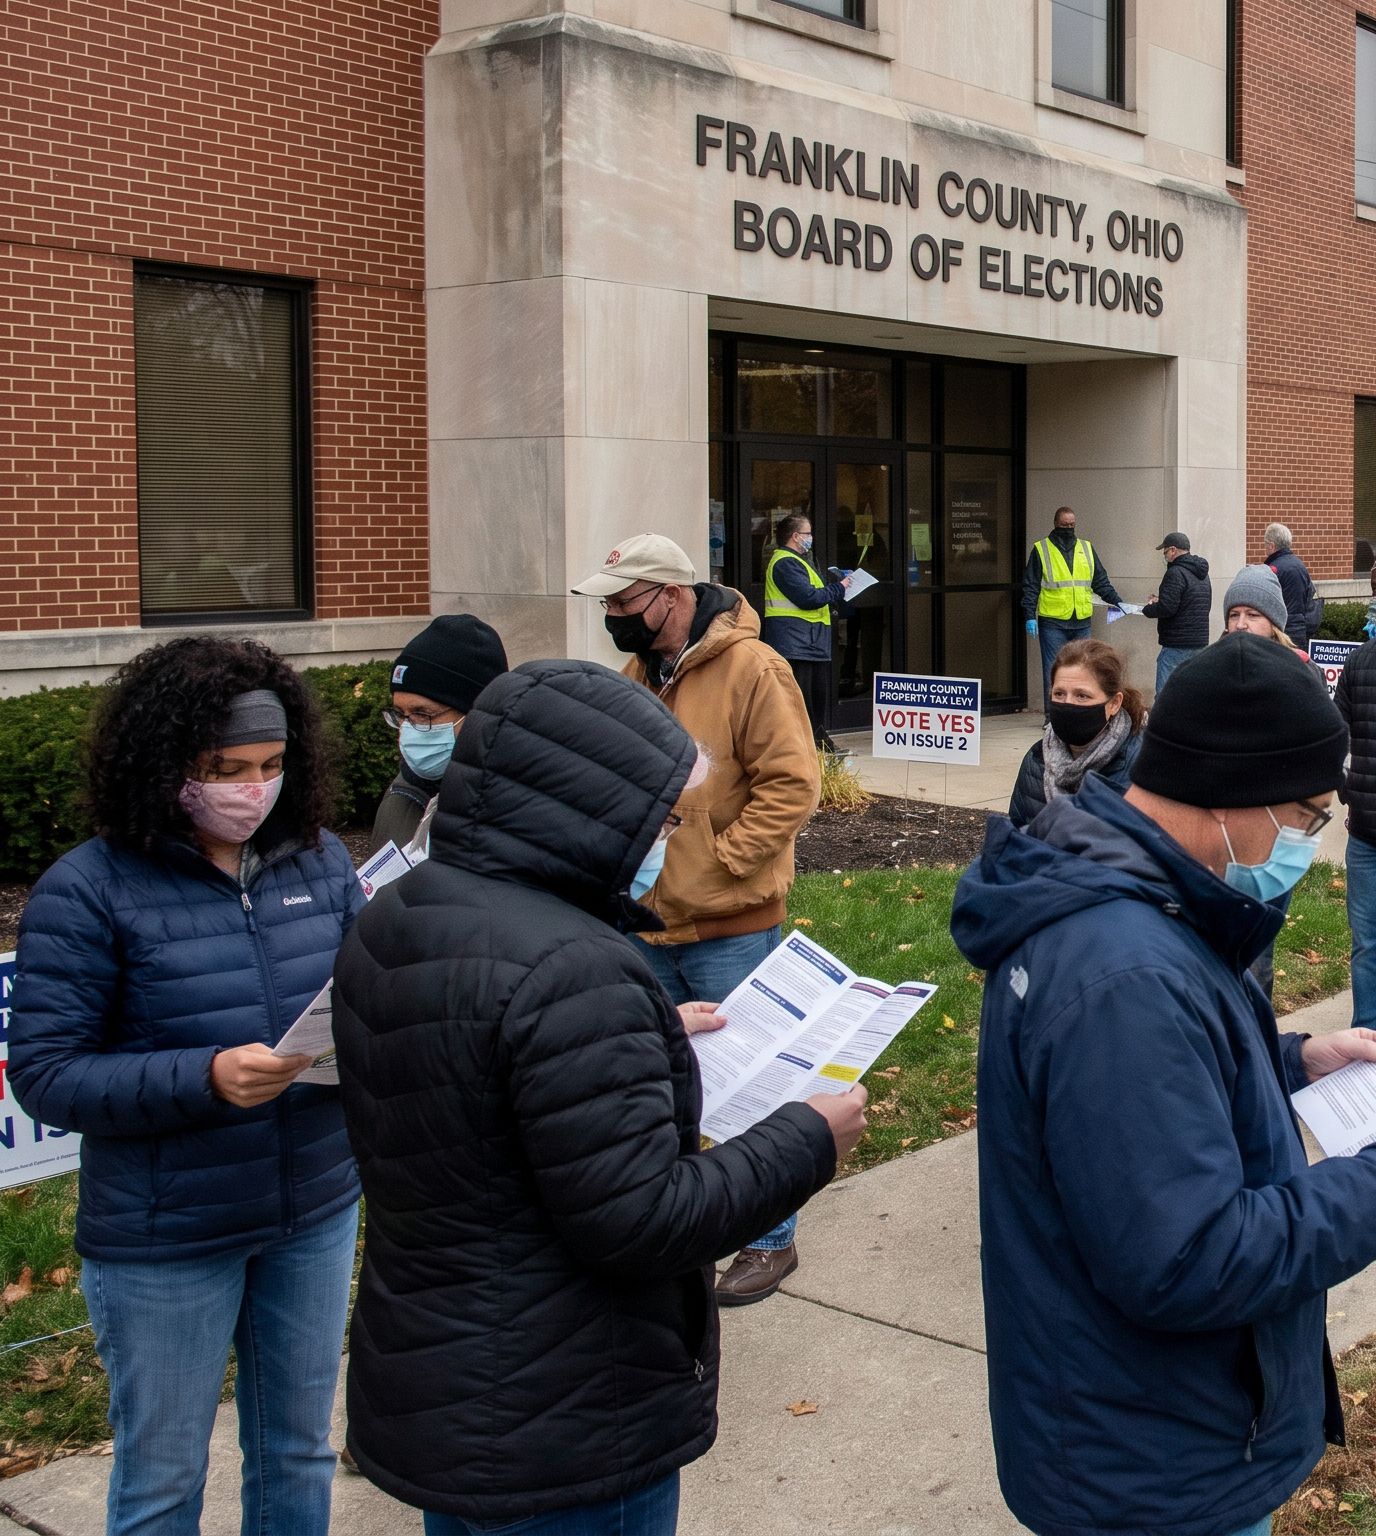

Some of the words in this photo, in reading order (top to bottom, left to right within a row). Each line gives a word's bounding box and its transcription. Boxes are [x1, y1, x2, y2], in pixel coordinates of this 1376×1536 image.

[696, 113, 920, 209] FRANKLIN
[937, 171, 1094, 254] COUNTY,
[1107, 210, 1184, 262] OHIO
[734, 200, 893, 271] BOARD
[910, 233, 964, 282] OF
[979, 246, 1164, 318] ELECTIONS
[882, 681, 927, 692] FRANKLIN
[930, 684, 969, 695] COUNTY
[930, 696, 948, 704] TAX
[951, 697, 973, 706] LEVY
[878, 709, 930, 730] VOTE
[937, 713, 975, 733] YES
[885, 732, 906, 746] ON
[912, 734, 953, 749] ISSUE
[958, 737, 967, 750] 2
